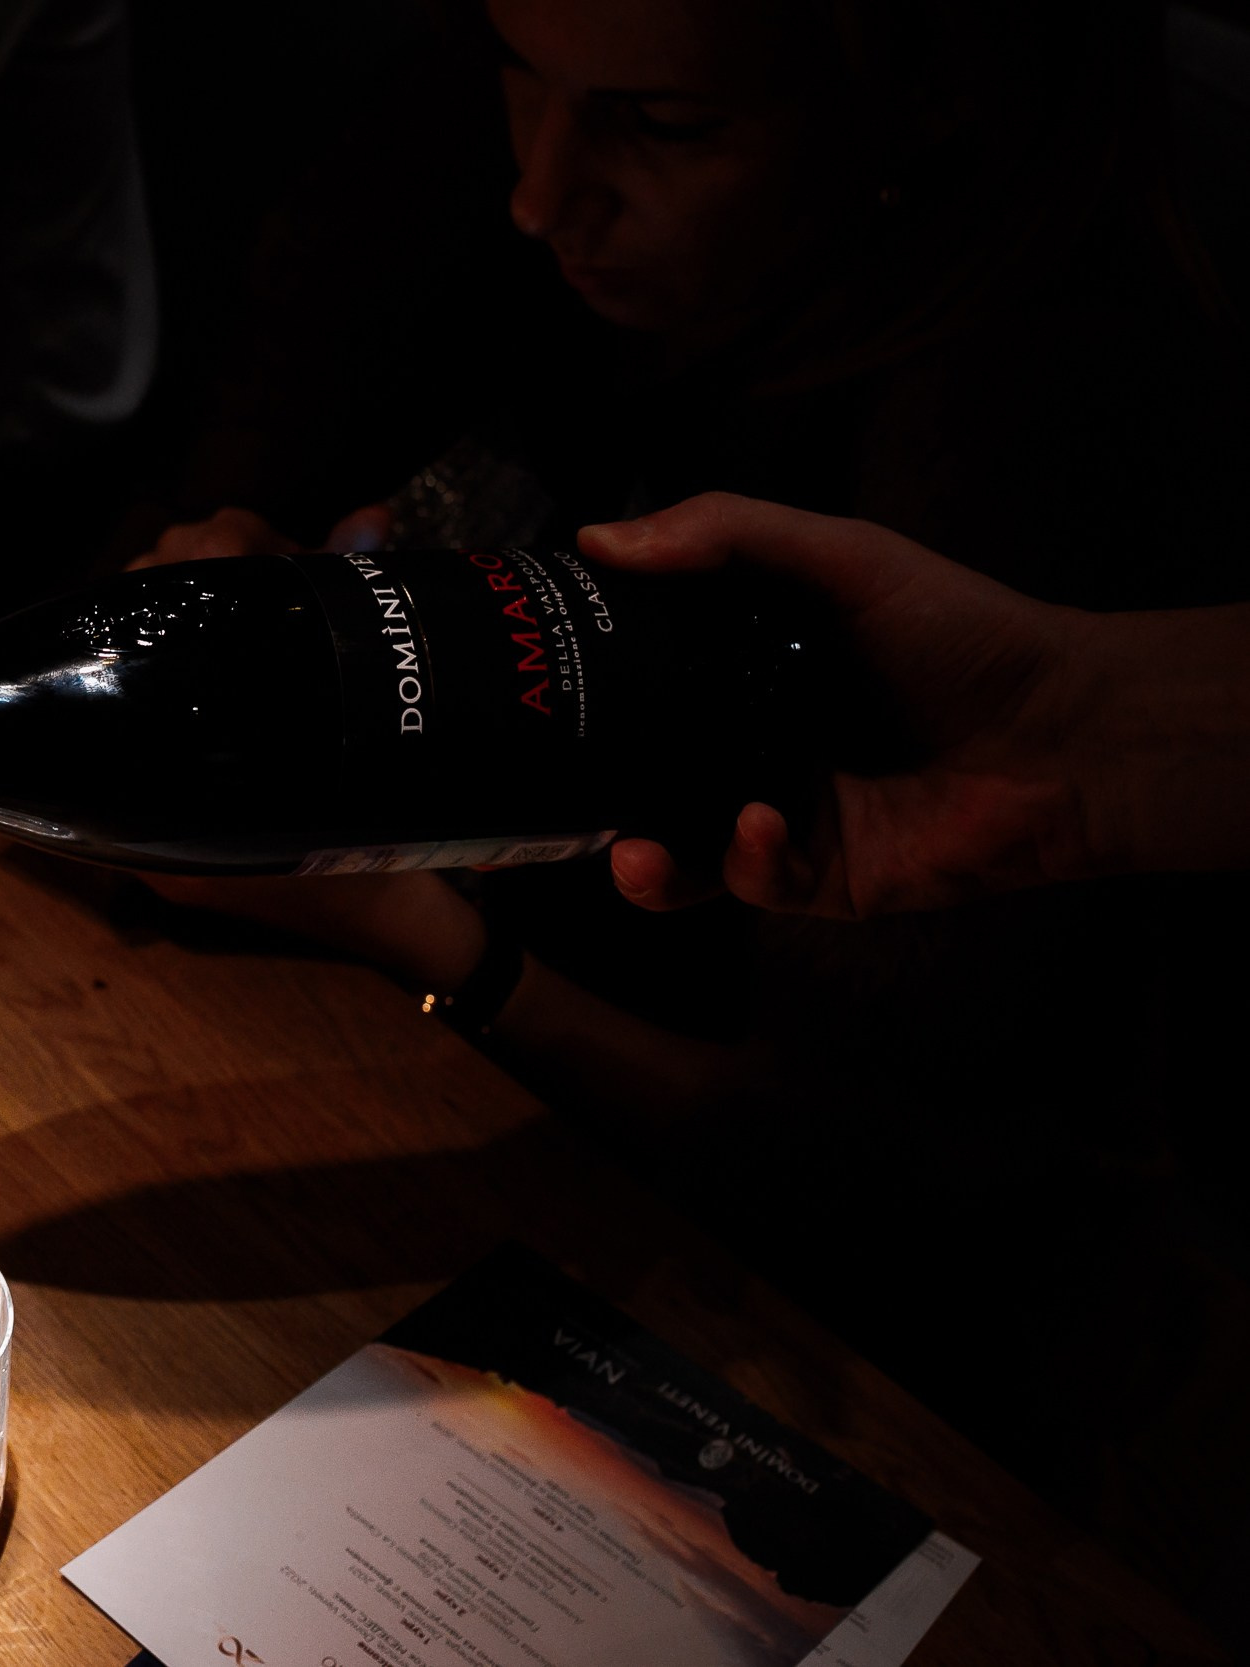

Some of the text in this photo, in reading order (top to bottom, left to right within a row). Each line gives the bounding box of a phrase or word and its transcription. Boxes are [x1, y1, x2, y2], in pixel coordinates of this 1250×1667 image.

[554, 551, 614, 633] CLASSICO
[551, 625, 573, 691] DELLA
[564, 619, 574, 632] di
[571, 636, 586, 738] Denominazione
[657, 1380, 731, 1436] VENETI
